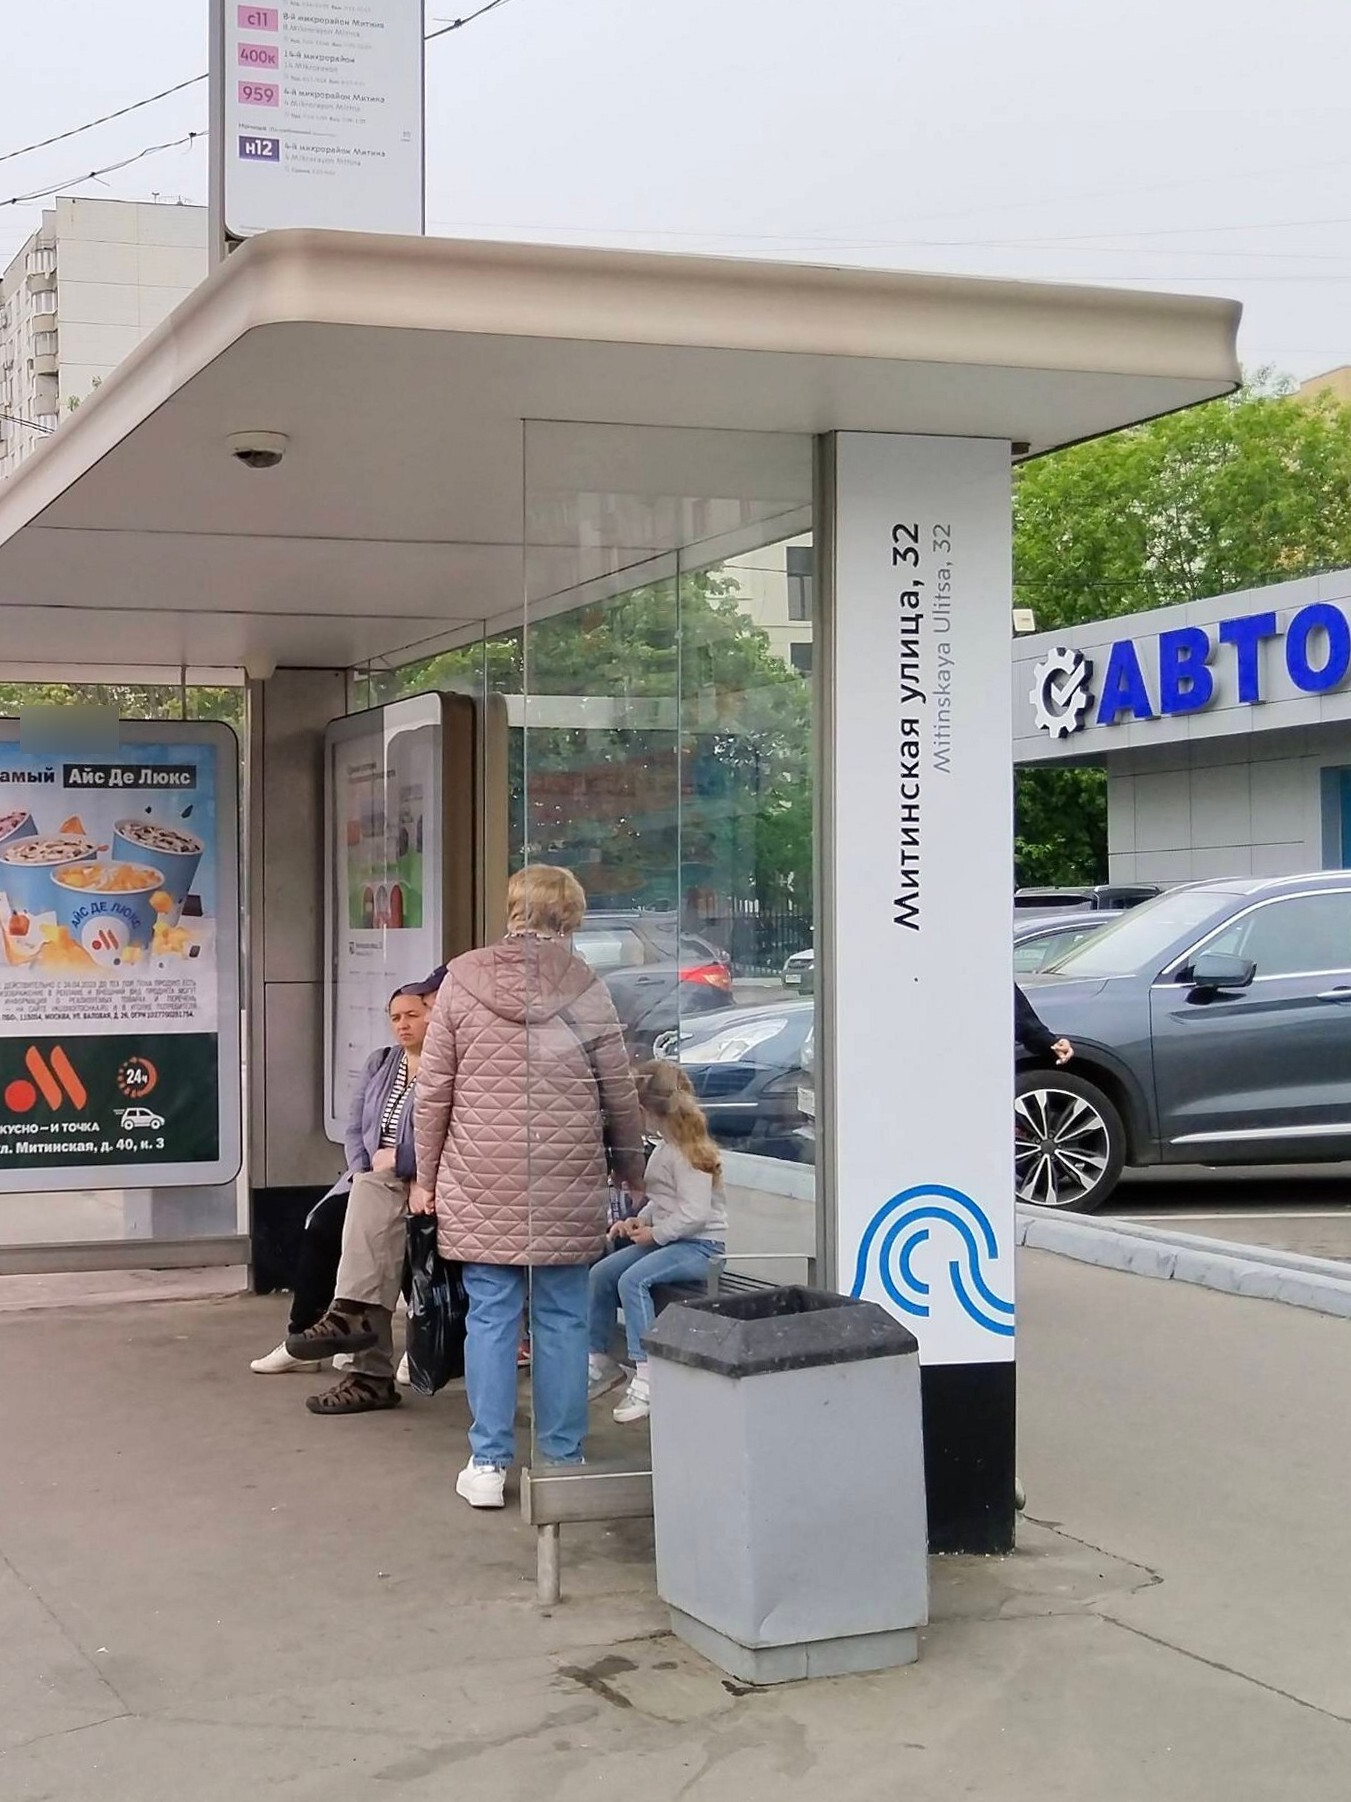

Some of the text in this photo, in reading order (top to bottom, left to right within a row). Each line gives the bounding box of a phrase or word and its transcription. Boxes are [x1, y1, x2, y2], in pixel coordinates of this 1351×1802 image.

[298, 16, 350, 26] микрорайон
[352, 19, 385, 29] Митина
[241, 48, 276, 64] 400к
[304, 53, 355, 63] микрорайон
[242, 86, 274, 102] 959
[298, 91, 350, 102] микрорайон
[353, 94, 385, 103] Митина
[299, 145, 350, 155] микрорайон
[353, 148, 386, 158] Митина
[932, 524, 955, 773] Mitinskaya Ulitsa, 32
[1096, 603, 1351, 725] АВТО
[892, 523, 926, 931] Митинская улица, 32
[69, 768, 106, 784] Айс
[109, 769, 135, 787] Де
[138, 769, 191, 785] Люкс
[71, 902, 141, 929] АЙС ДЕ ЛЮКС
[61, 1122, 100, 1133] ТОЧКА
[16, 1141, 98, 1154] Митинская,
[100, 1141, 113, 1153] д.
[116, 1138, 137, 1152] 40,
[155, 1137, 165, 1149] 3
